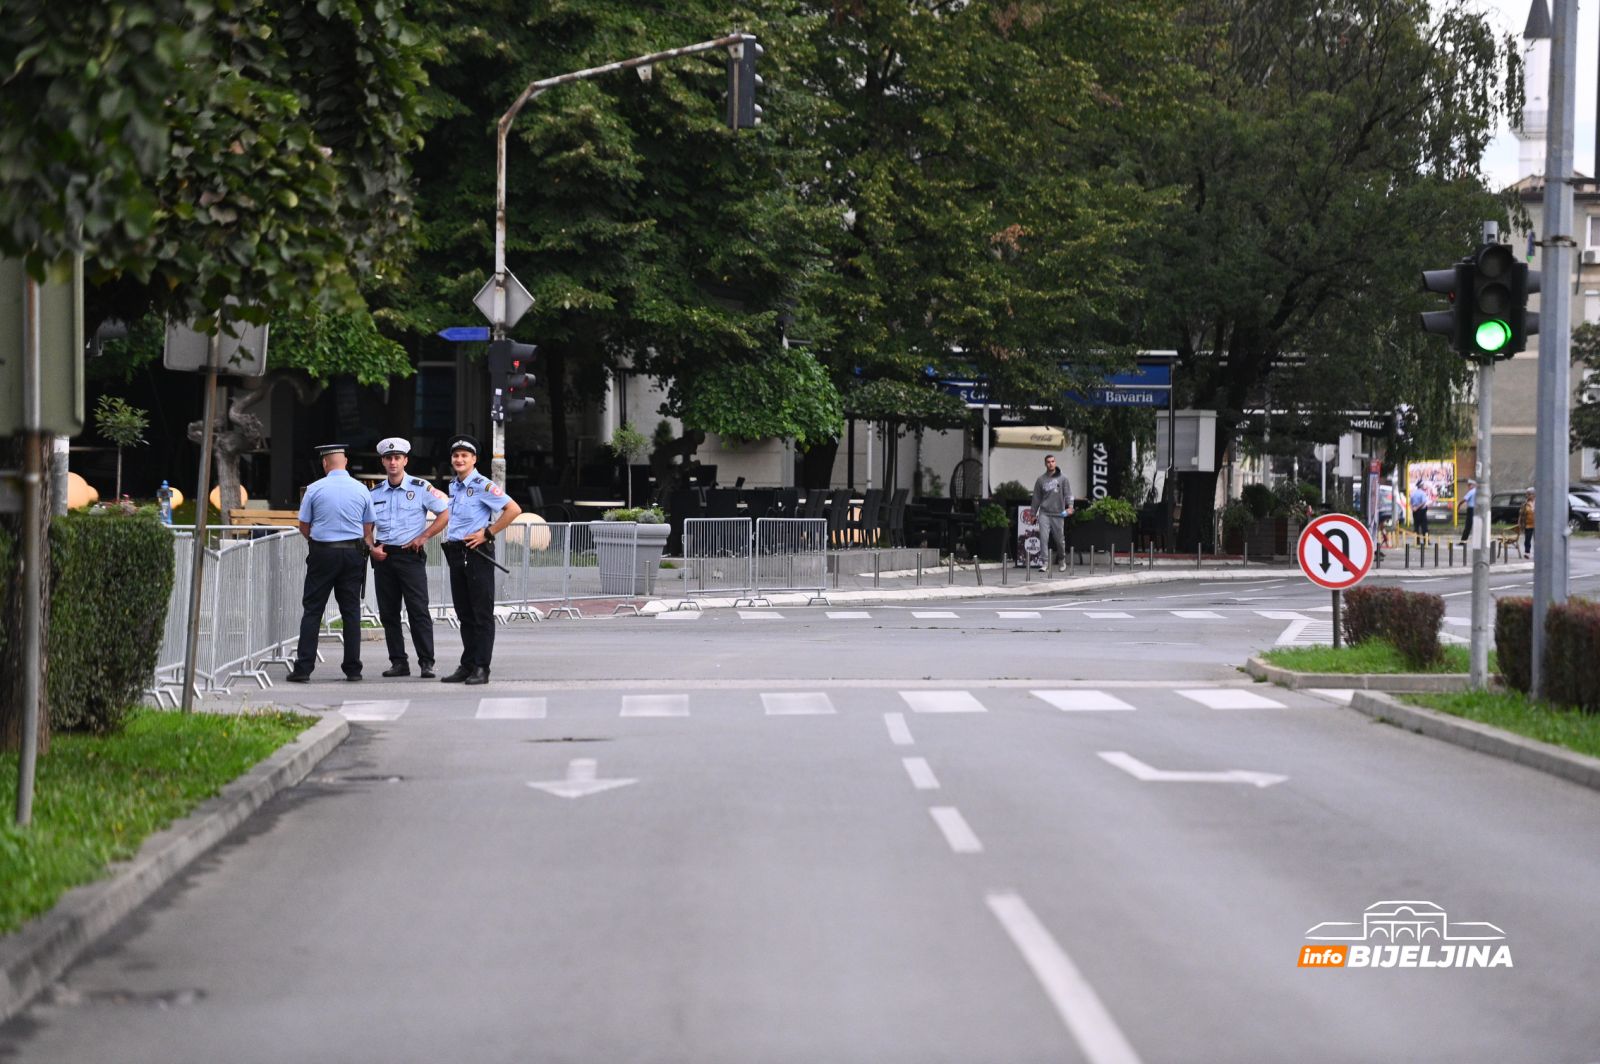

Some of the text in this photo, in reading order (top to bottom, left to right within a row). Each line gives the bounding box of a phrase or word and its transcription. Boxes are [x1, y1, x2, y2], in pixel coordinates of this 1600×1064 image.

[1105, 391, 1153, 403] Bavaria
[1350, 419, 1385, 430] Nektar
[1092, 442, 1108, 501] OTEKA
